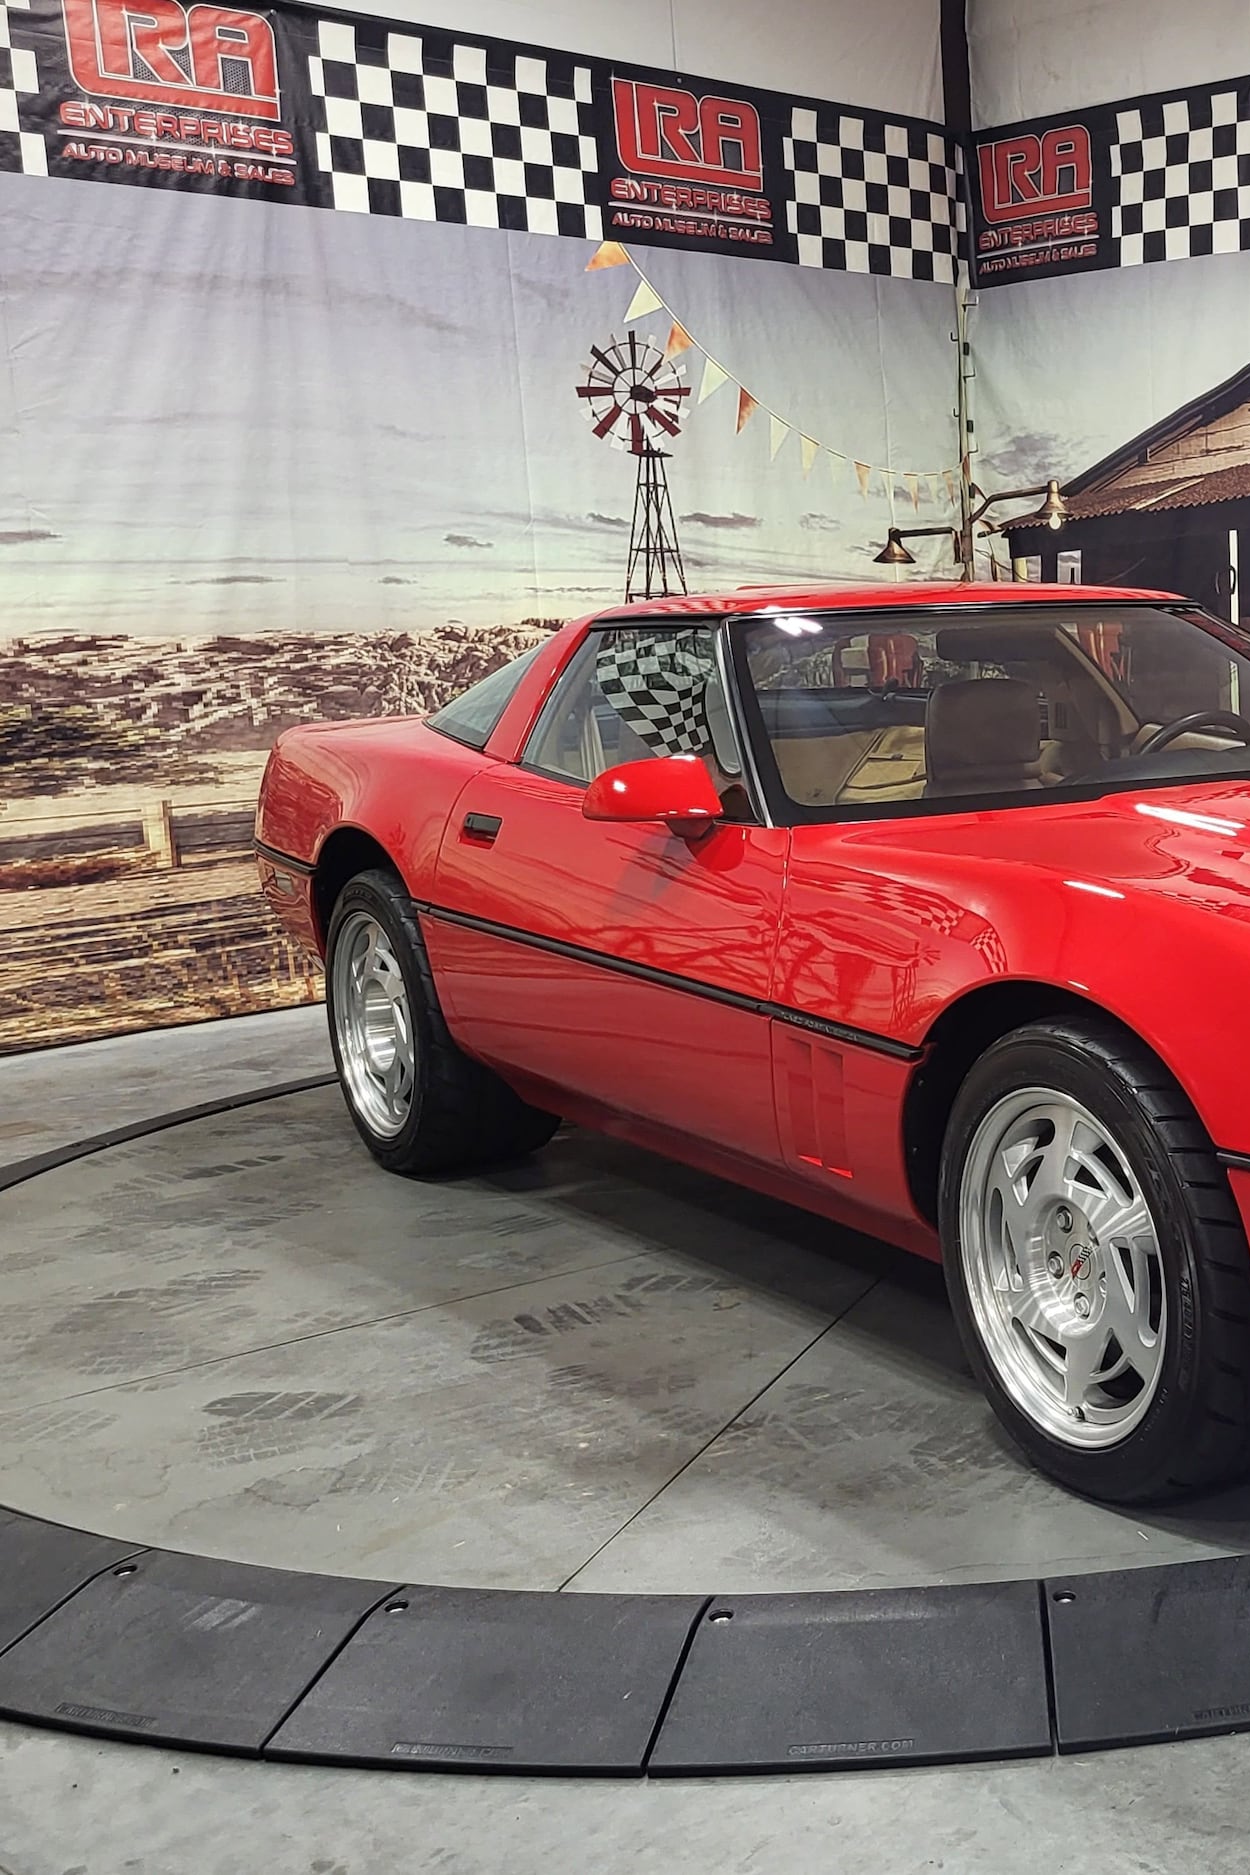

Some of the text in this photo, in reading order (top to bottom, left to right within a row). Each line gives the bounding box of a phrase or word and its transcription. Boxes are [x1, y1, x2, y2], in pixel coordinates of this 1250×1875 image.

[59, 100, 294, 155] ENTERPRISES
[62, 142, 296, 186] AUTO MUSEUM & SALES
[610, 177, 772, 219] ENTERPRISES
[611, 212, 773, 245] AUTO MUSEUM & SALES
[979, 212, 1098, 250] ENTERPRISES
